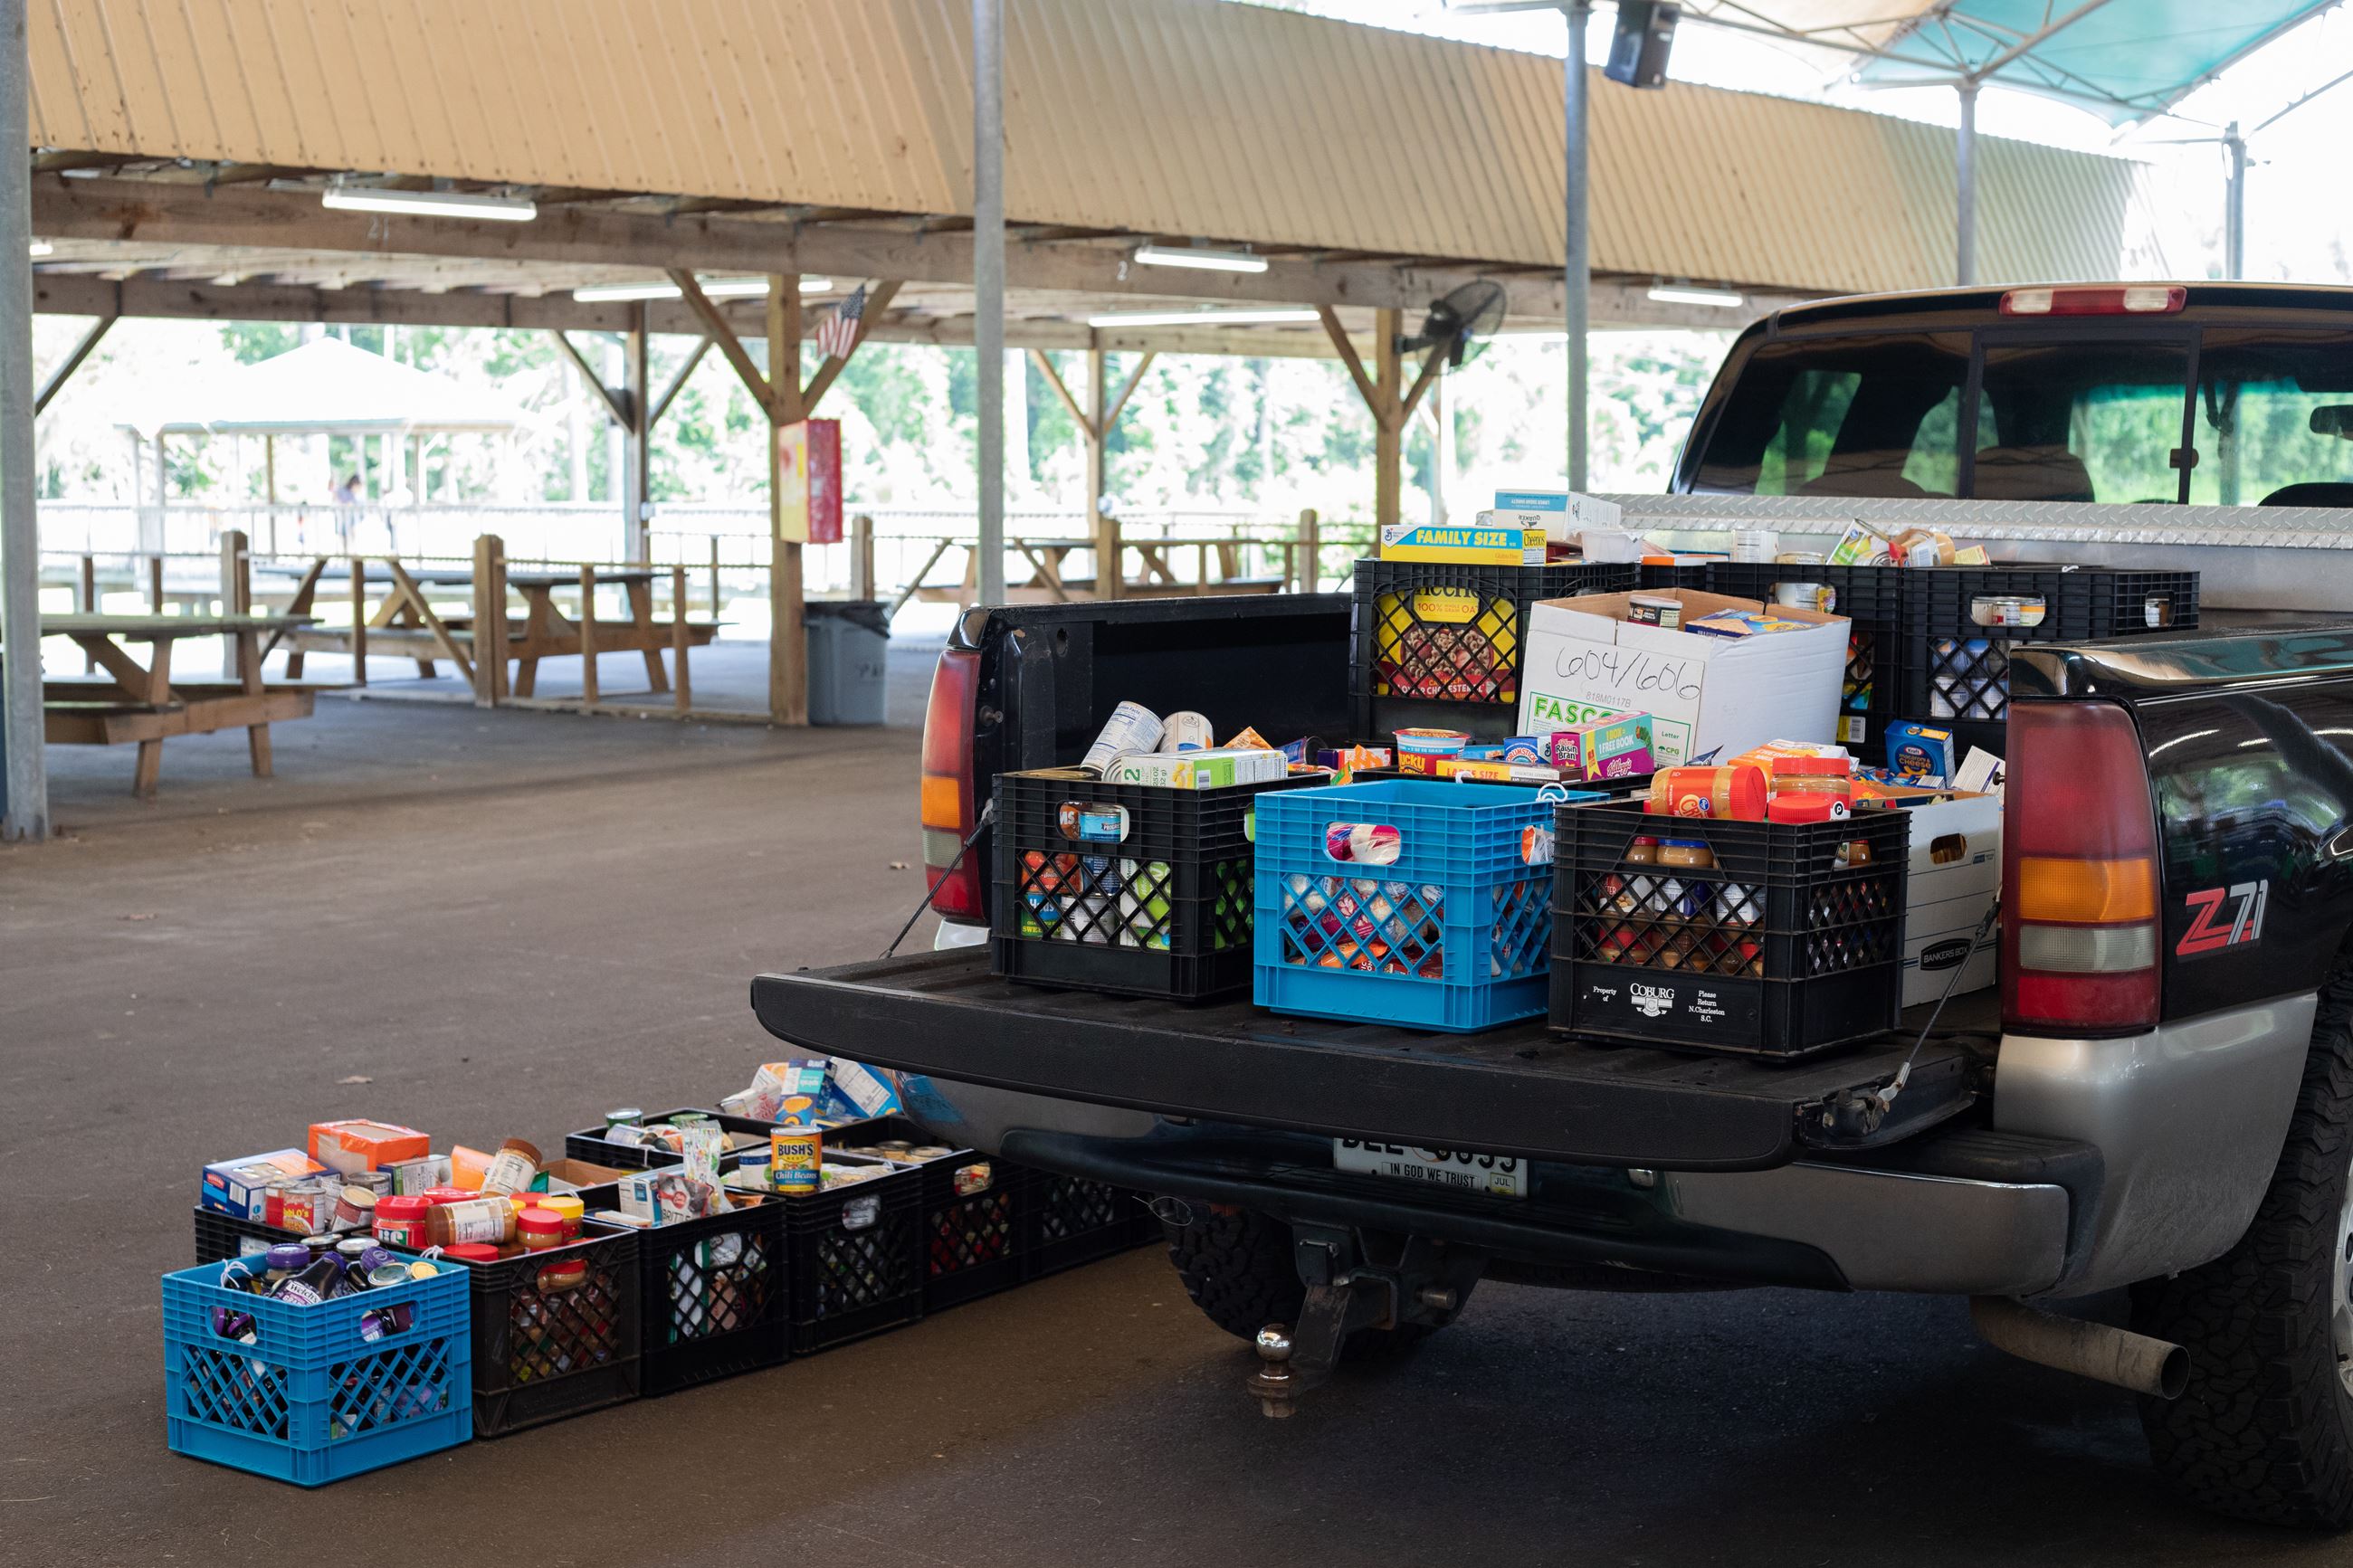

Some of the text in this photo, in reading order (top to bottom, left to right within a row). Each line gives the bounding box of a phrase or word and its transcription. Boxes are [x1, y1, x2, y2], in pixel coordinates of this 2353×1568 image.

[1416, 529, 1474, 545] FAMILY
[1474, 531, 1508, 546] SIZE
[1523, 533, 1545, 547] Cheerios
[1462, 603, 1478, 613] OA
[1556, 647, 1700, 700] 604/606
[1586, 691, 1632, 708] 818M0117B
[1662, 731, 1680, 739] Letter
[1556, 745, 1578, 753] Raisin
[1603, 740, 1615, 753] FREE
[1615, 735, 1634, 749] BOOK
[1558, 752, 1576, 760] Bran
[1666, 746, 1680, 755] CPG
[1480, 770, 1500, 780] SIZE
[2176, 879, 2269, 955] Z71
[1923, 946, 1968, 964] BANKERS BOX
[1593, 985, 1617, 995] Property
[1630, 983, 1675, 999] COBURG
[1698, 990, 1717, 999] Please
[1697, 998, 1717, 1007] Return
[1689, 1005, 1725, 1016] N.Charleston
[778, 1143, 814, 1156] BUSH'S
[776, 1171, 817, 1180] Chili Beans
[1389, 1163, 1476, 1188] IN GOD WE TRUST
[1494, 1177, 1510, 1187] JUL
[289, 1281, 318, 1303] Welch's
